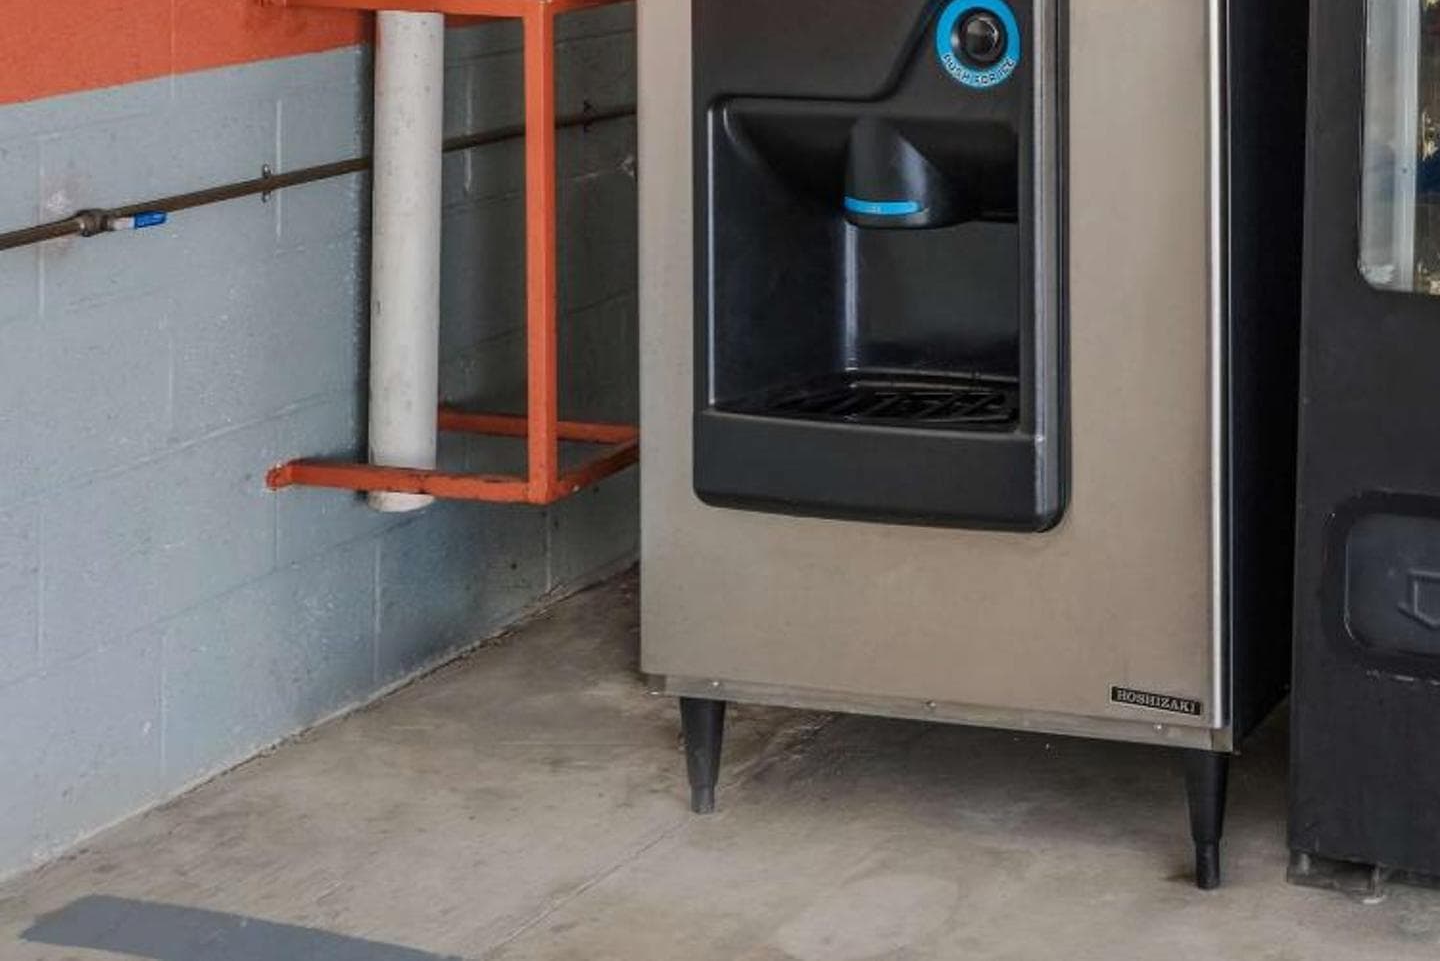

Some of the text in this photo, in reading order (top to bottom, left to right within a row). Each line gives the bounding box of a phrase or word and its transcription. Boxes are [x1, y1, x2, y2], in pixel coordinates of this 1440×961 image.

[943, 53, 1016, 84] PUSH FOR ICE
[1116, 689, 1196, 713] HOSHIZAKI
